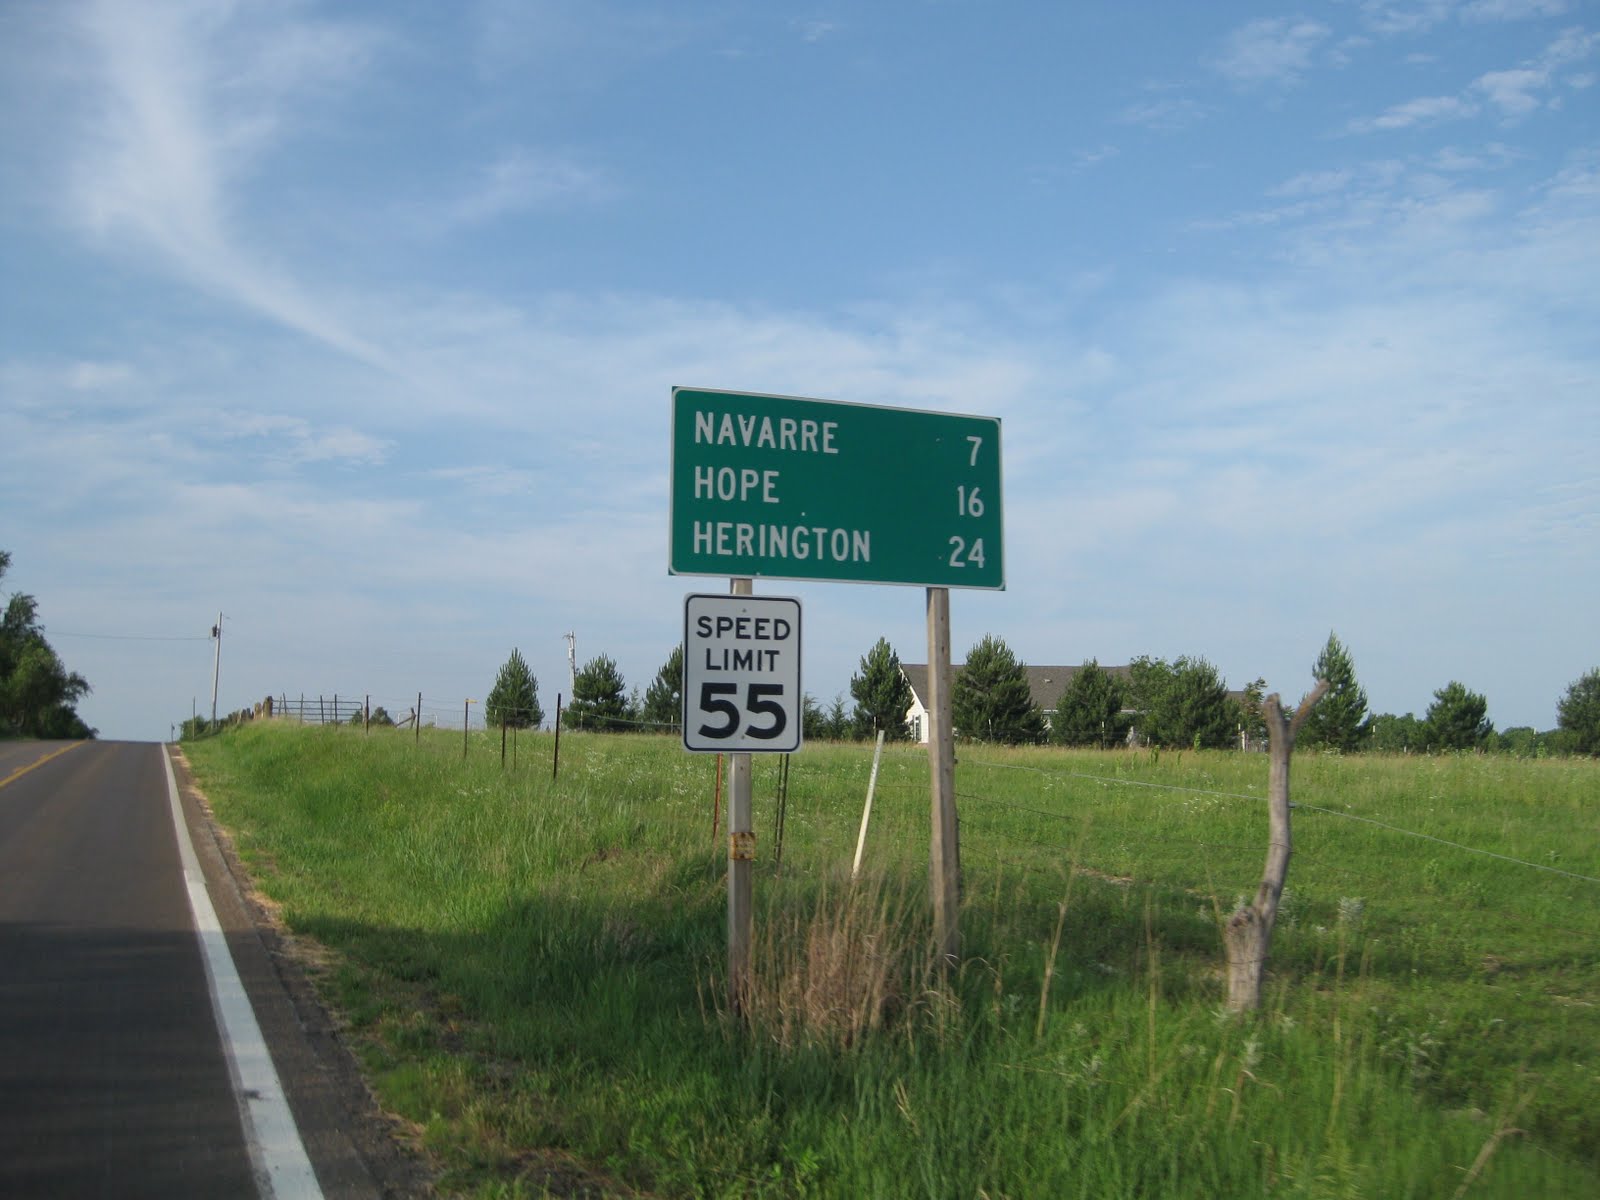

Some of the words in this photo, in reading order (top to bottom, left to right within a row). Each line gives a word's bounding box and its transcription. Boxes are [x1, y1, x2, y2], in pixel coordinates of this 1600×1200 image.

[694, 411, 839, 454] NAVARRE
[966, 436, 983, 466] 7
[695, 466, 780, 503] HOPE
[957, 485, 985, 518] 16
[693, 521, 871, 562] HERINGTON
[948, 535, 985, 569] 24
[696, 615, 791, 641] SPEED
[705, 648, 780, 673] LIMIT
[698, 682, 787, 740] 55
